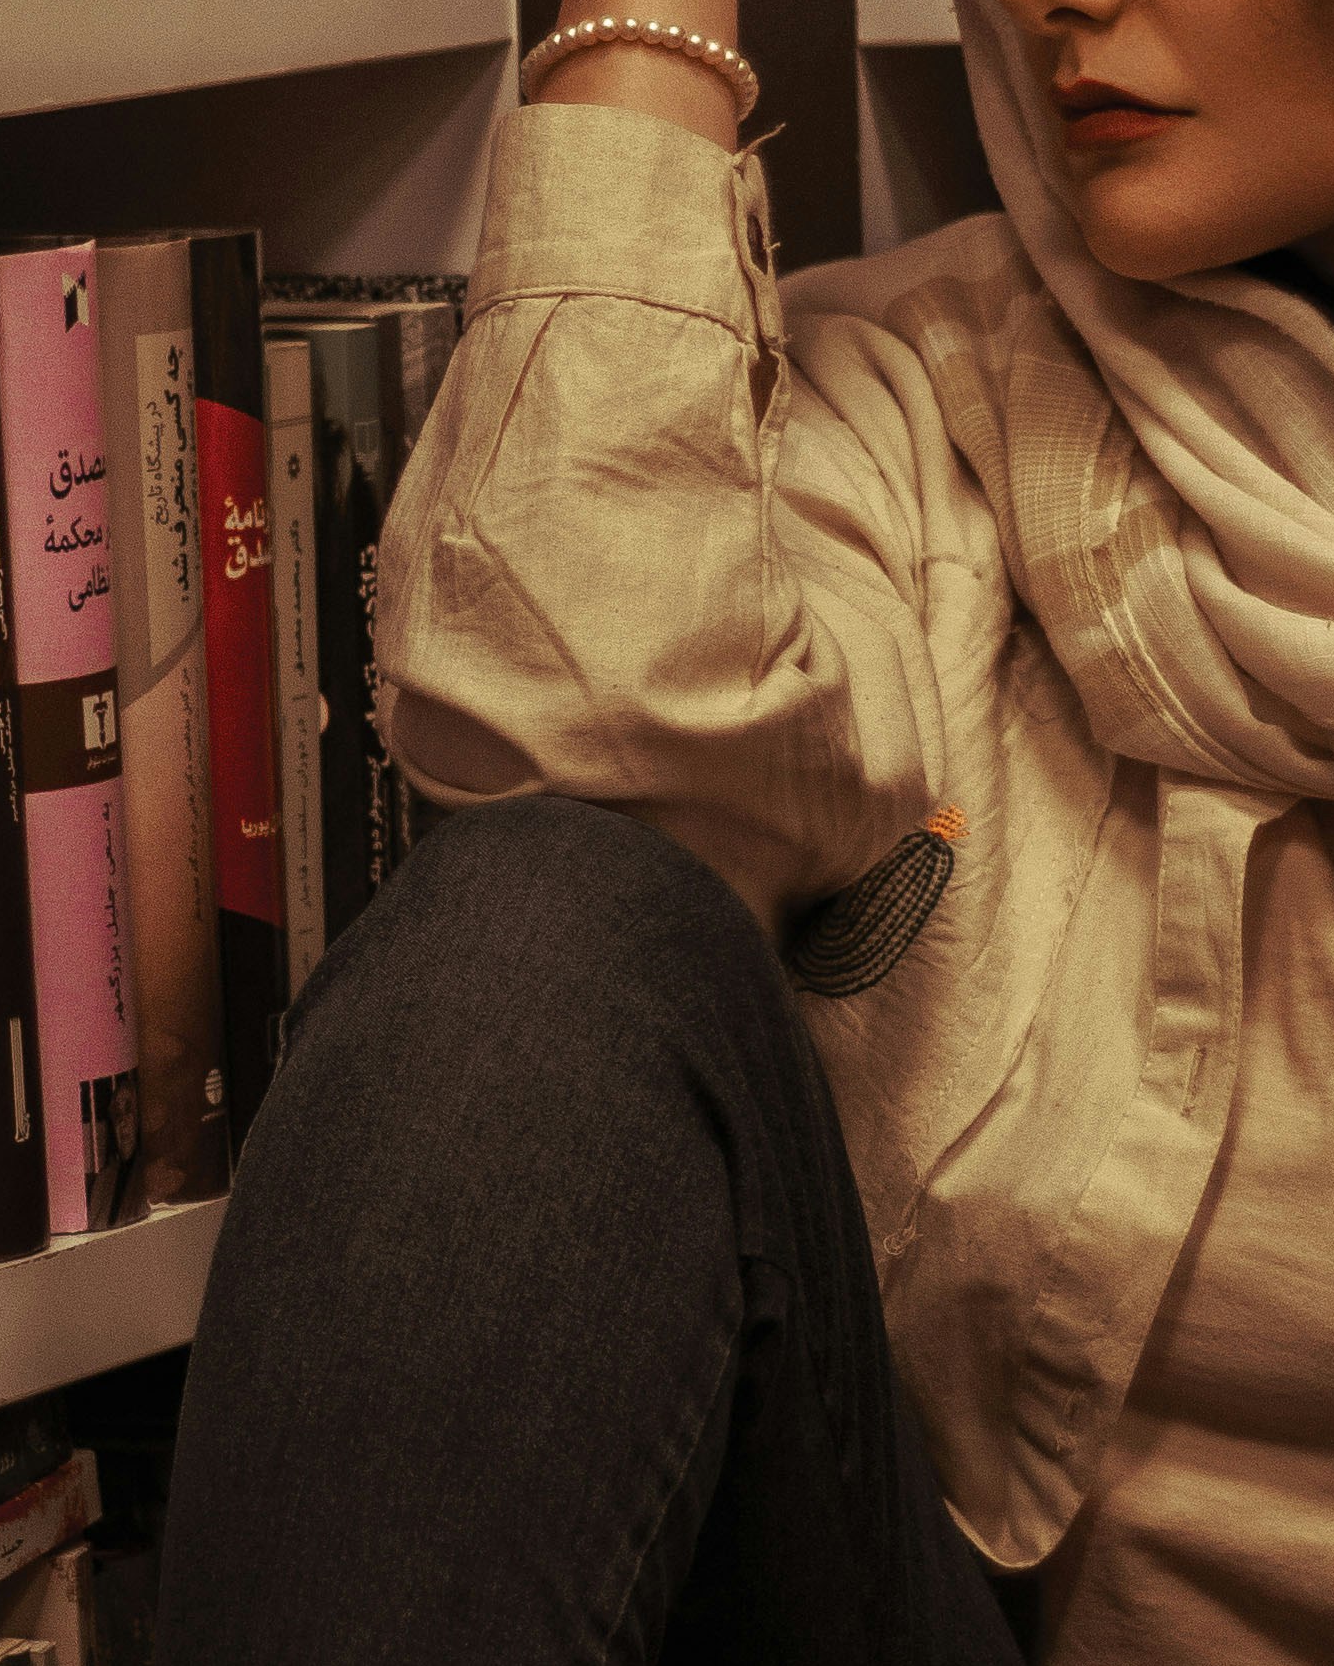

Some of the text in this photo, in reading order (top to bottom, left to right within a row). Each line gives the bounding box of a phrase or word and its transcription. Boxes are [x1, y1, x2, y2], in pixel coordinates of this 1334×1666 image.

[165, 345, 182, 381] چه
[164, 388, 186, 450] کسی
[147, 484, 169, 525] تاریخ
